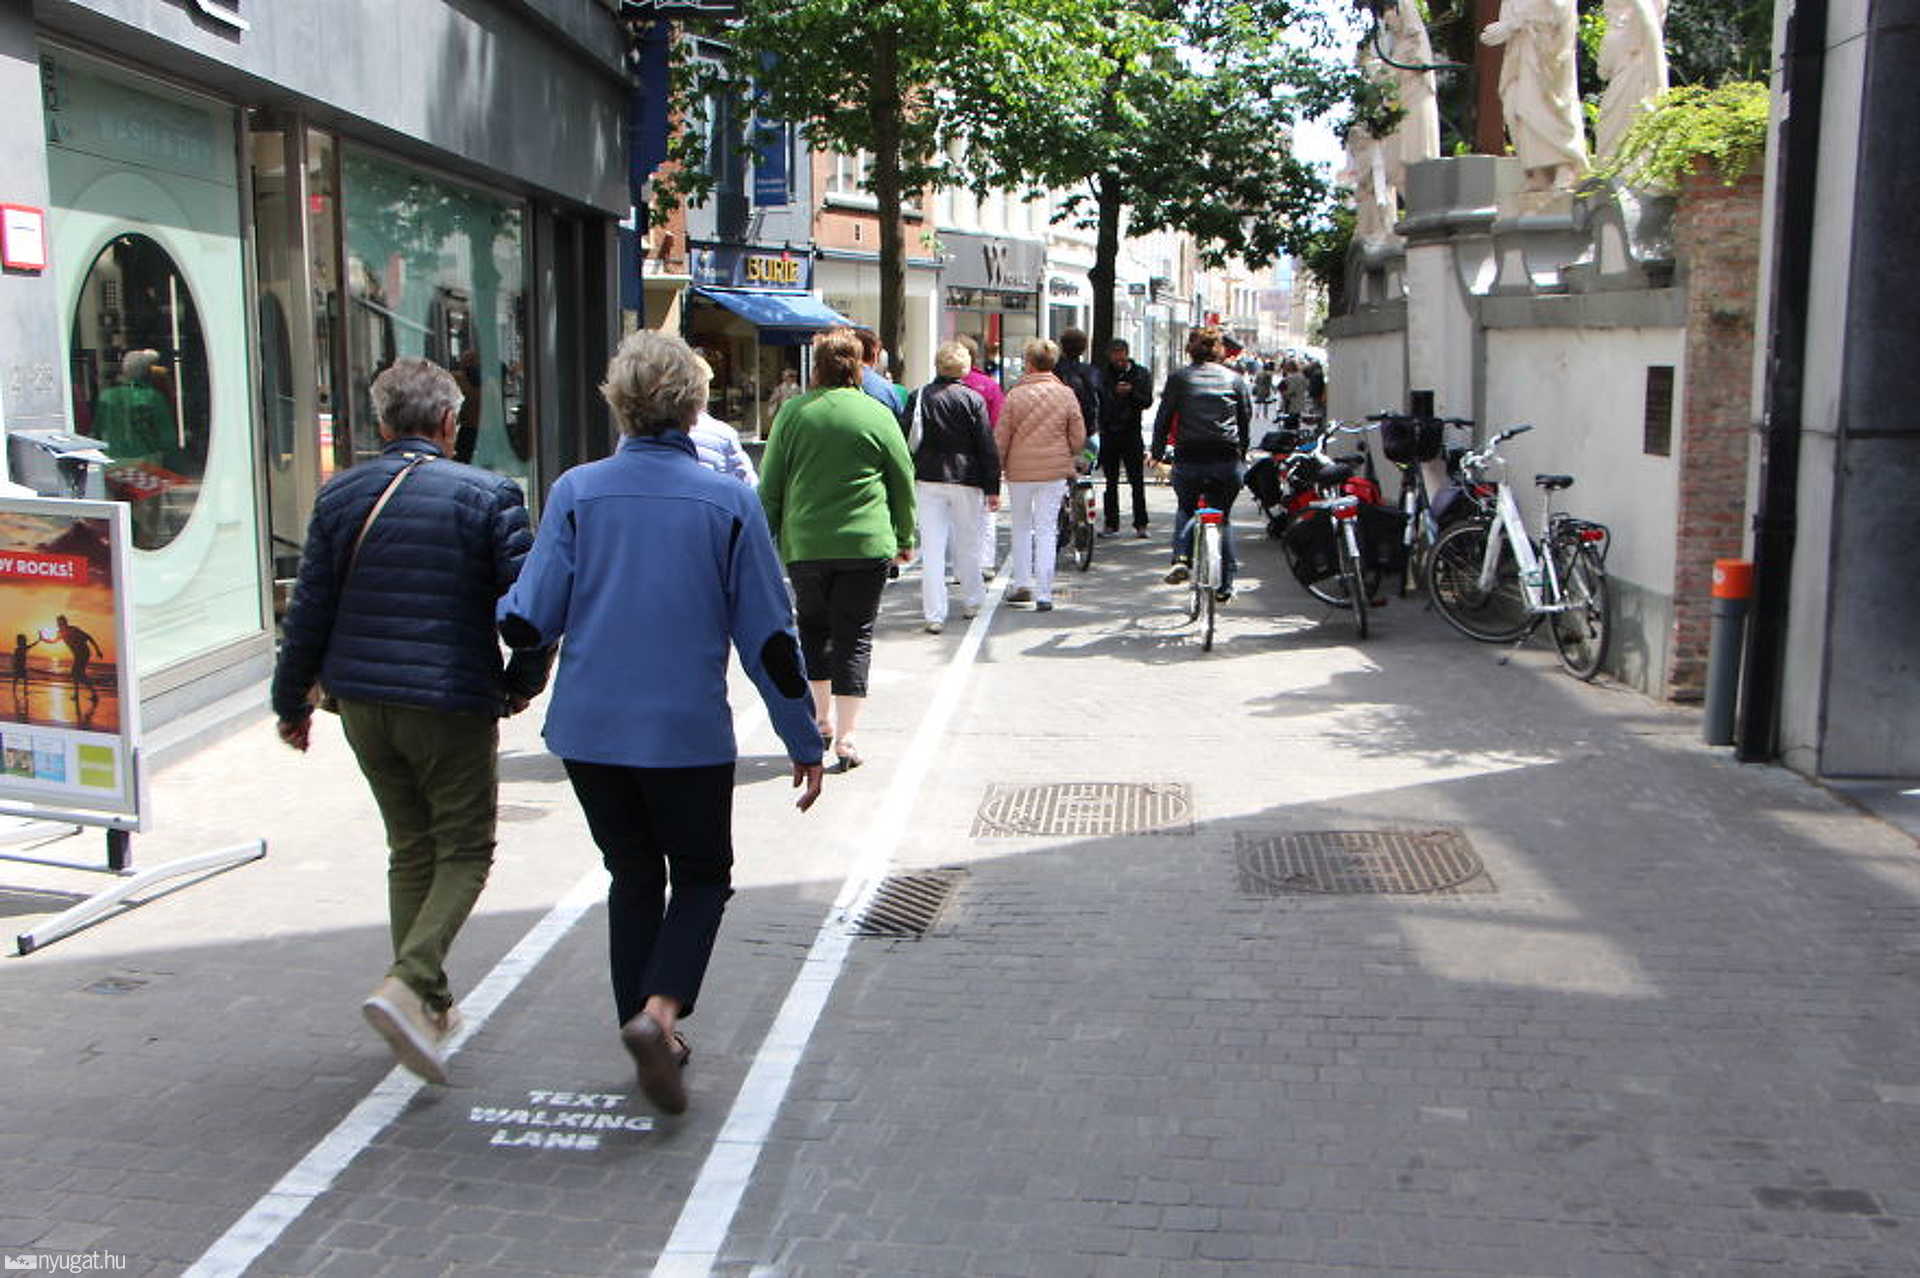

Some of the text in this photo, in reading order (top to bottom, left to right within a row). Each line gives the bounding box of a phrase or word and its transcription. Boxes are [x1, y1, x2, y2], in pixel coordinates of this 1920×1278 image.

[746, 255, 801, 282] BURIE
[17, 559, 74, 578] ROCKS!
[528, 1090, 627, 1109] TEXT
[469, 1106, 655, 1131] WALKING
[489, 1129, 601, 1150] LANE
